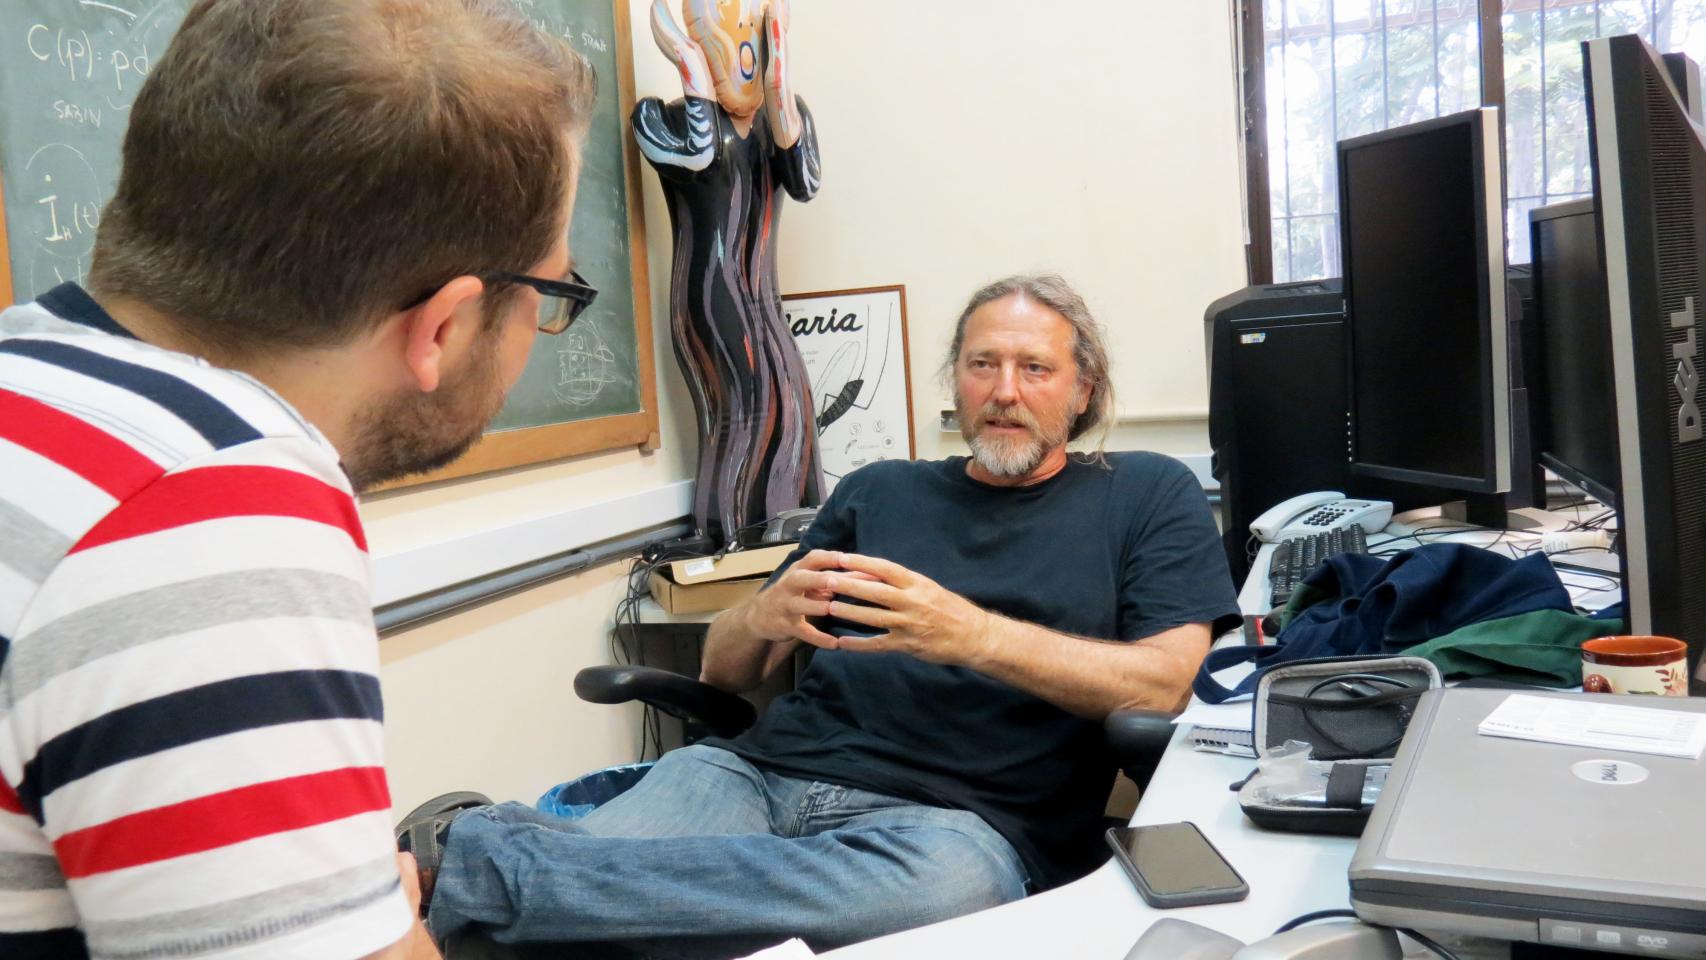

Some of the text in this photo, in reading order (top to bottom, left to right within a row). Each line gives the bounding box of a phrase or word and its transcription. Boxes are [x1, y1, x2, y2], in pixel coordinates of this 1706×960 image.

[1670, 296, 1703, 444] DELL
[1600, 762, 1618, 782] DELL
[1636, 934, 1669, 947] DVD
